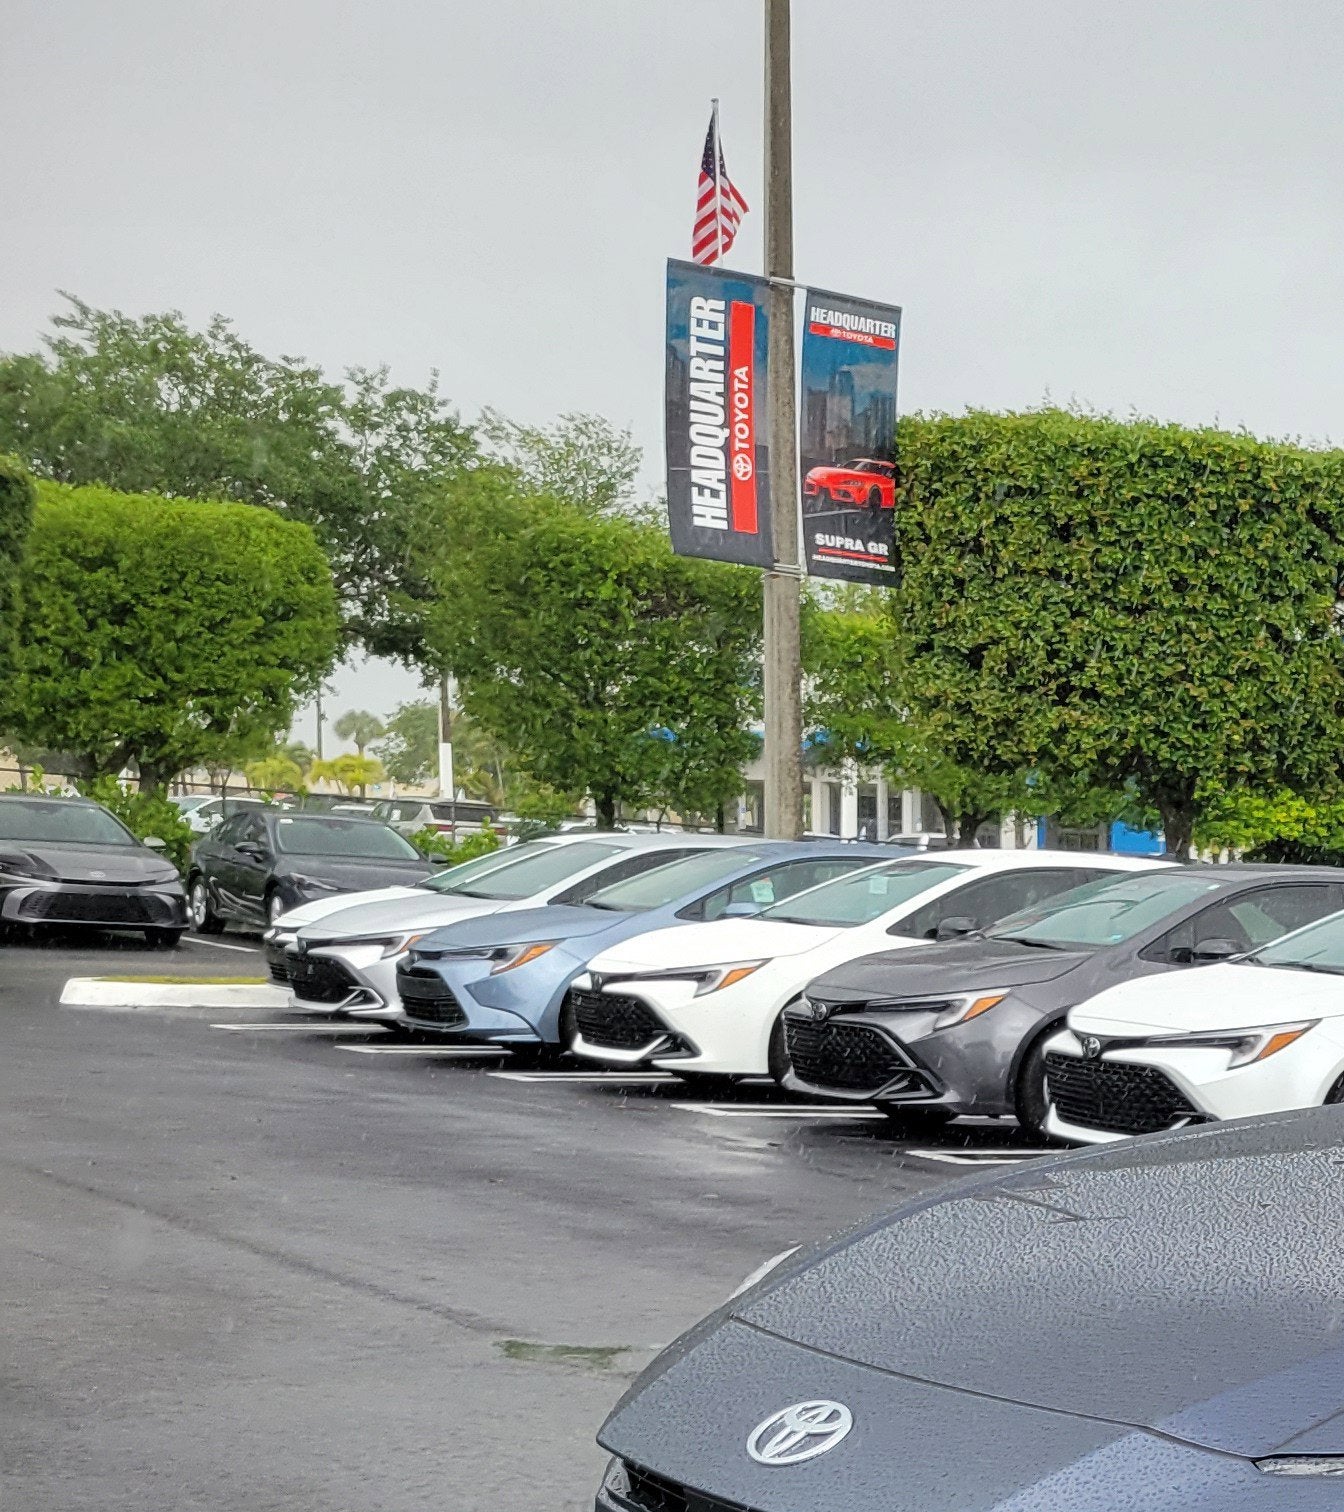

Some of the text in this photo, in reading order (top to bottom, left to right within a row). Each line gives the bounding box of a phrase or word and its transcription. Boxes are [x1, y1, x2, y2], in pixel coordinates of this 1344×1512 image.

[810, 306, 896, 339] HEADQUARTER
[842, 331, 874, 344] TOYOTA
[689, 296, 730, 531] HEADQUARTER
[733, 365, 750, 451] TOYOTA
[814, 532, 889, 556] SUPRA GR
